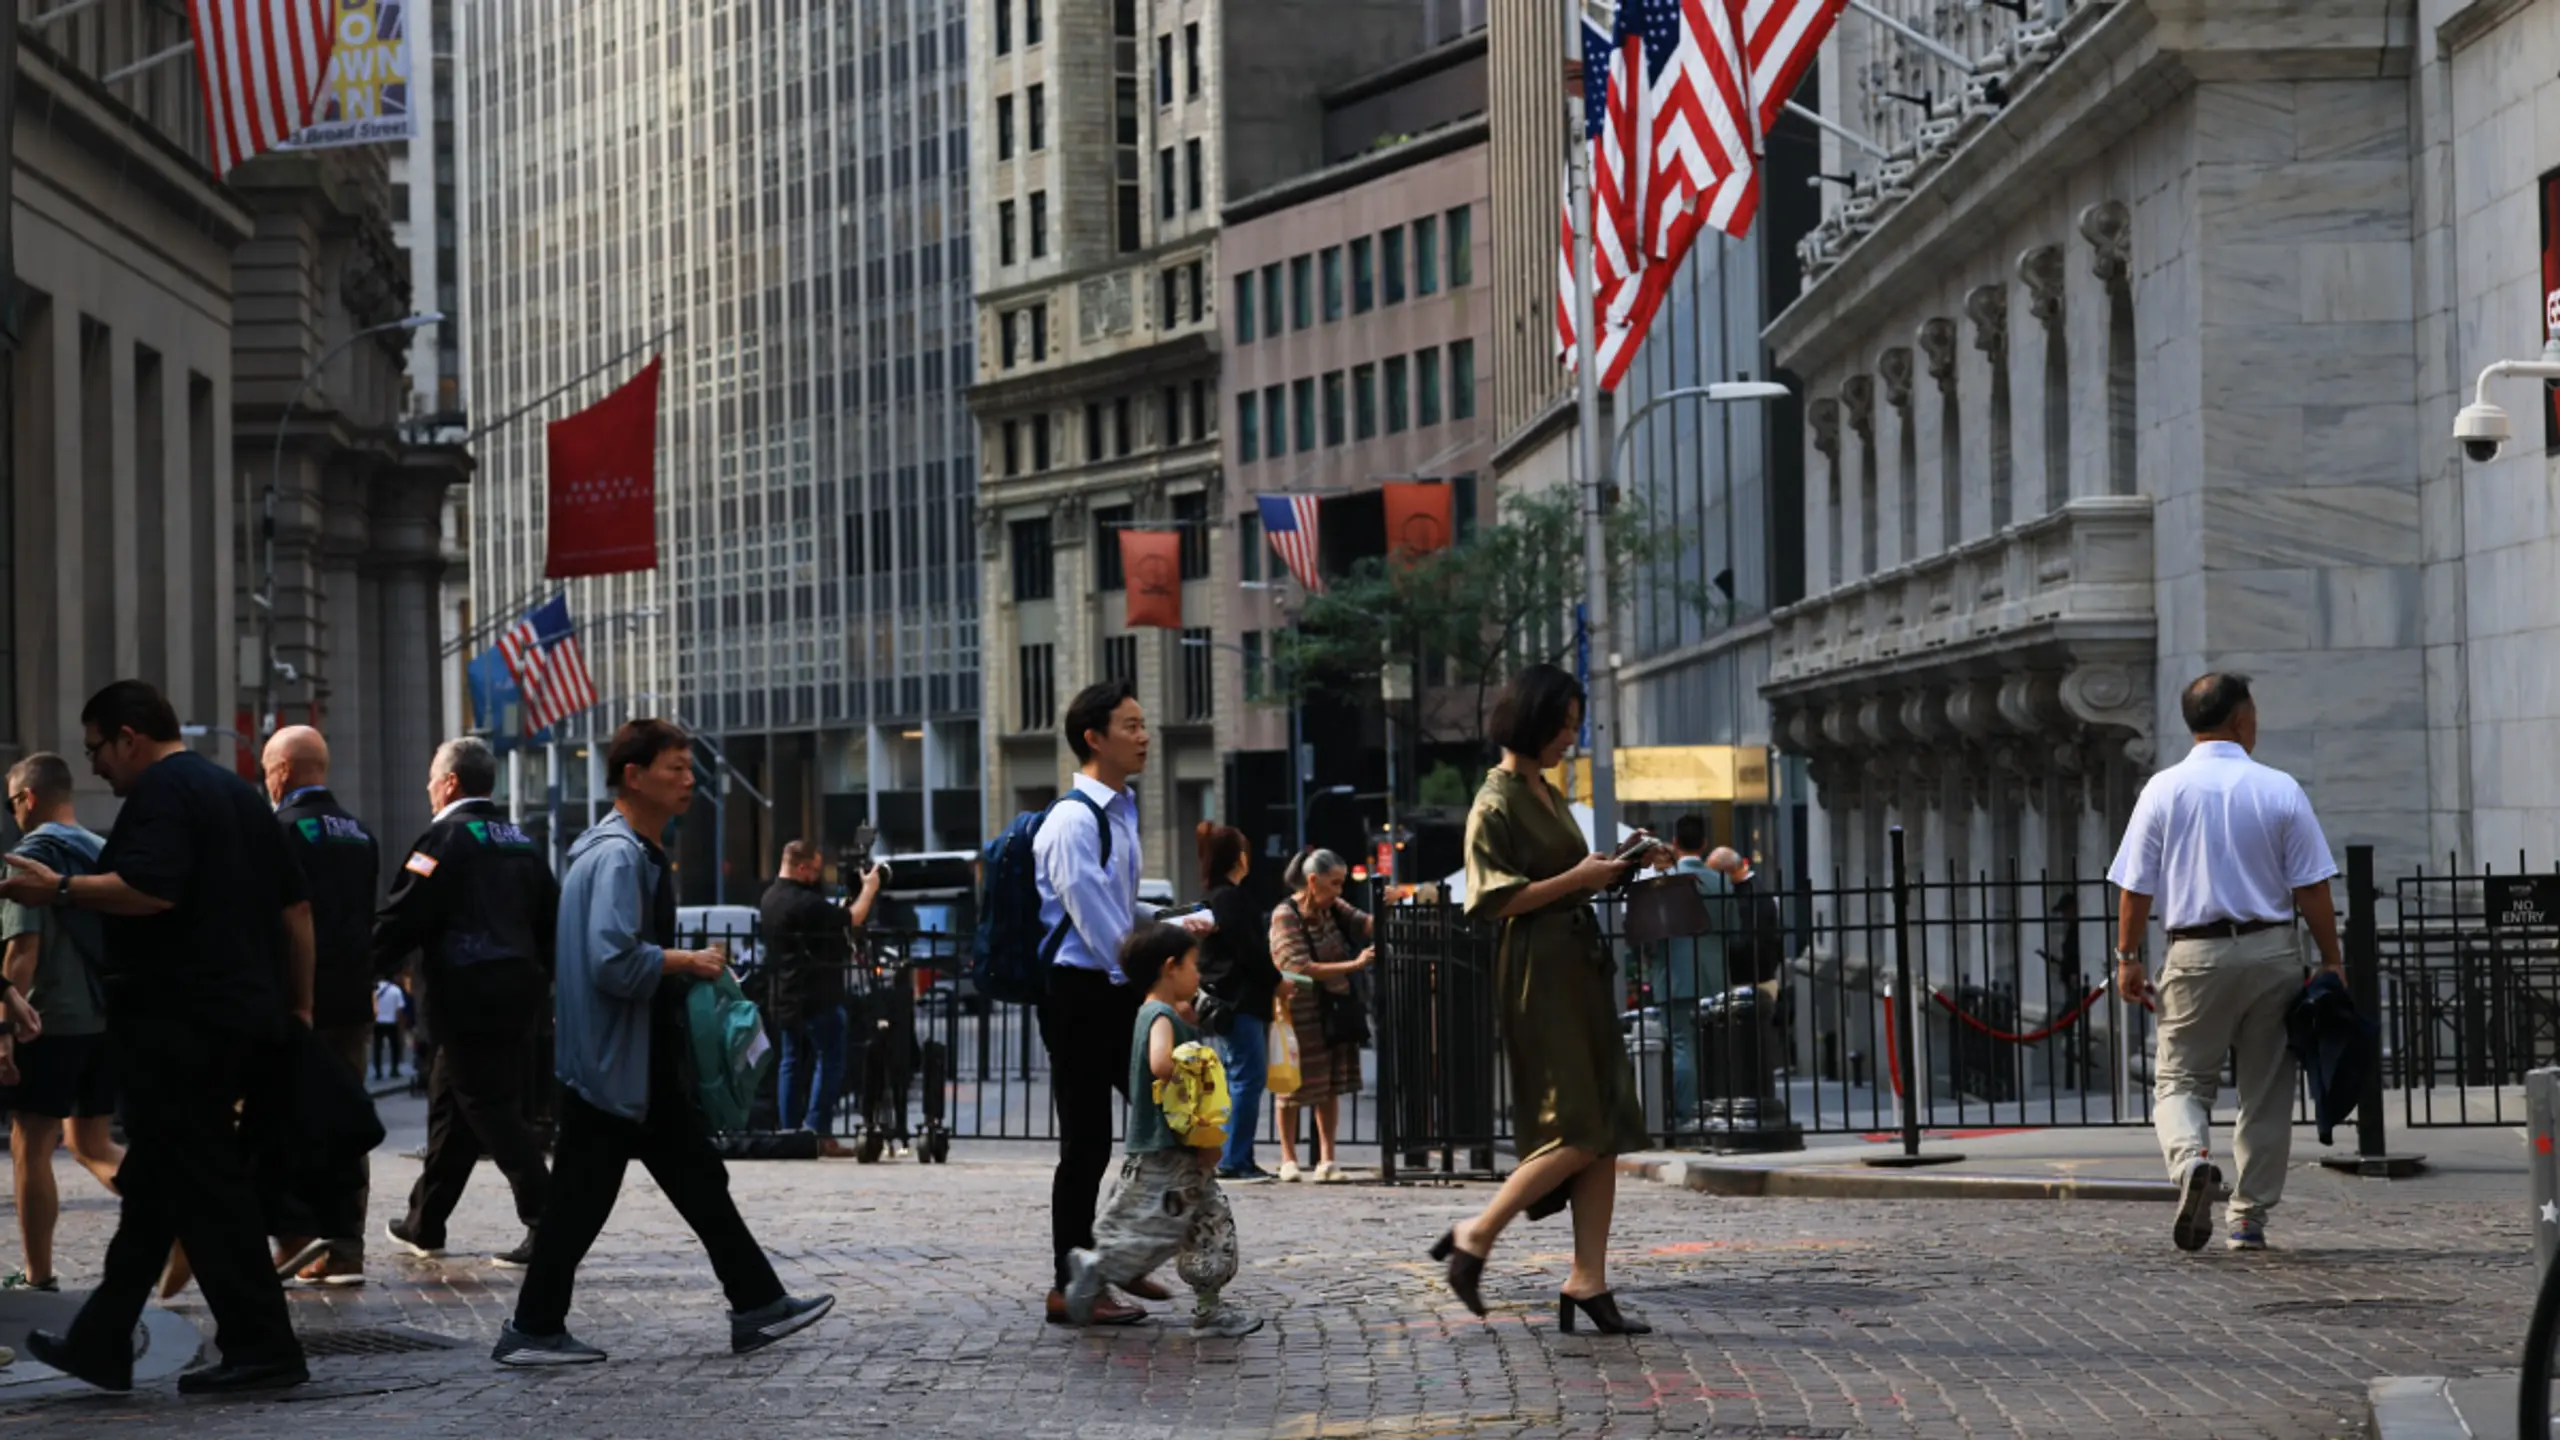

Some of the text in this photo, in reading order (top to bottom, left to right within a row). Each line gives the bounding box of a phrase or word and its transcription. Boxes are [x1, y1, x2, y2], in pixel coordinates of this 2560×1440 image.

[305, 126, 356, 144] Broad
[360, 121, 407, 138] Street
[2512, 900, 2534, 911] NO
[2502, 911, 2545, 923] ENTRY
